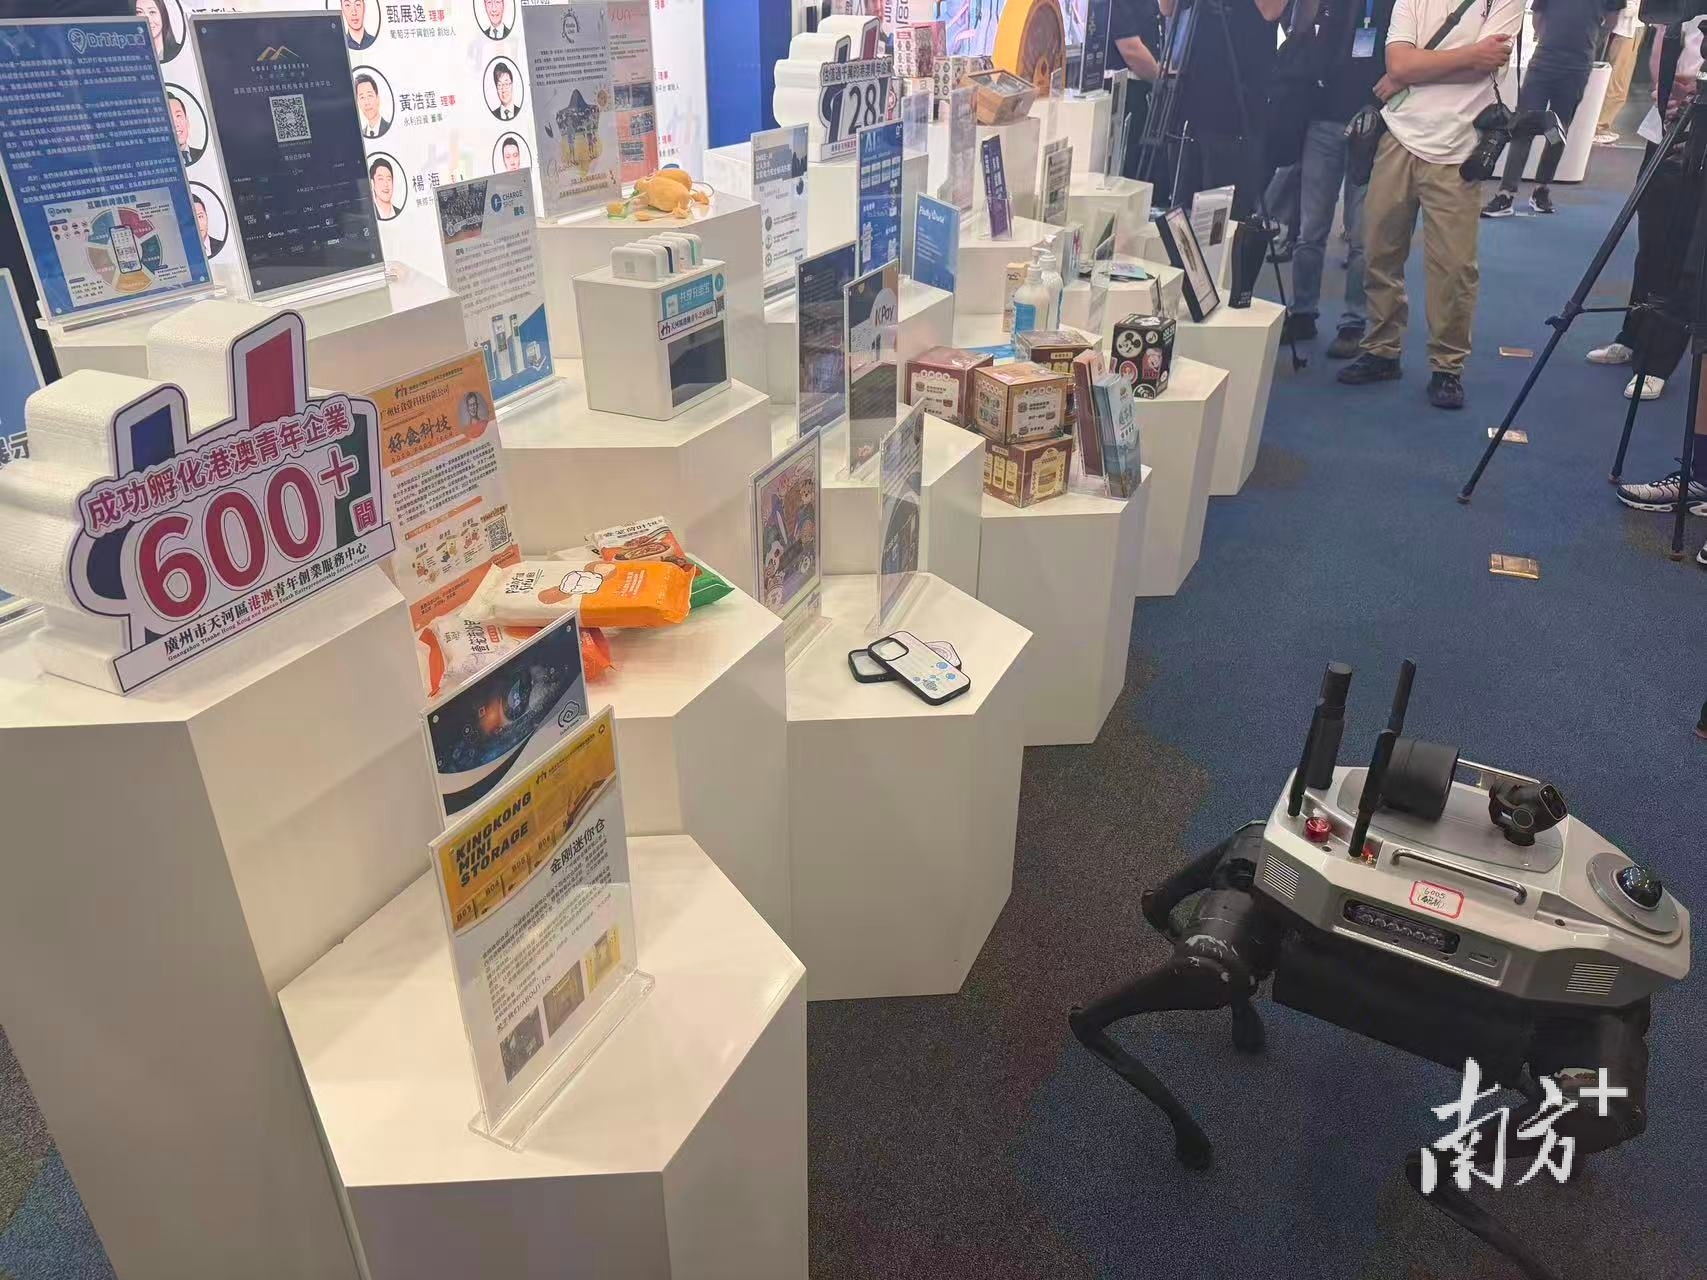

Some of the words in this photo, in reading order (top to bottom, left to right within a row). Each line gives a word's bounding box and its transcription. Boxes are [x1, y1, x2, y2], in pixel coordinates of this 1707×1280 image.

[88, 403, 350, 530] 成功孵化港澳青年企業
[163, 542, 368, 655] 廣州市天河區港澳青年創業服務中心
[168, 641, 201, 661] Guangzhou
[456, 791, 532, 863] KINGKONG
[458, 838, 492, 875] MINI
[461, 821, 529, 888] STORAGE
[550, 818, 605, 876] 金刚迷你仓
